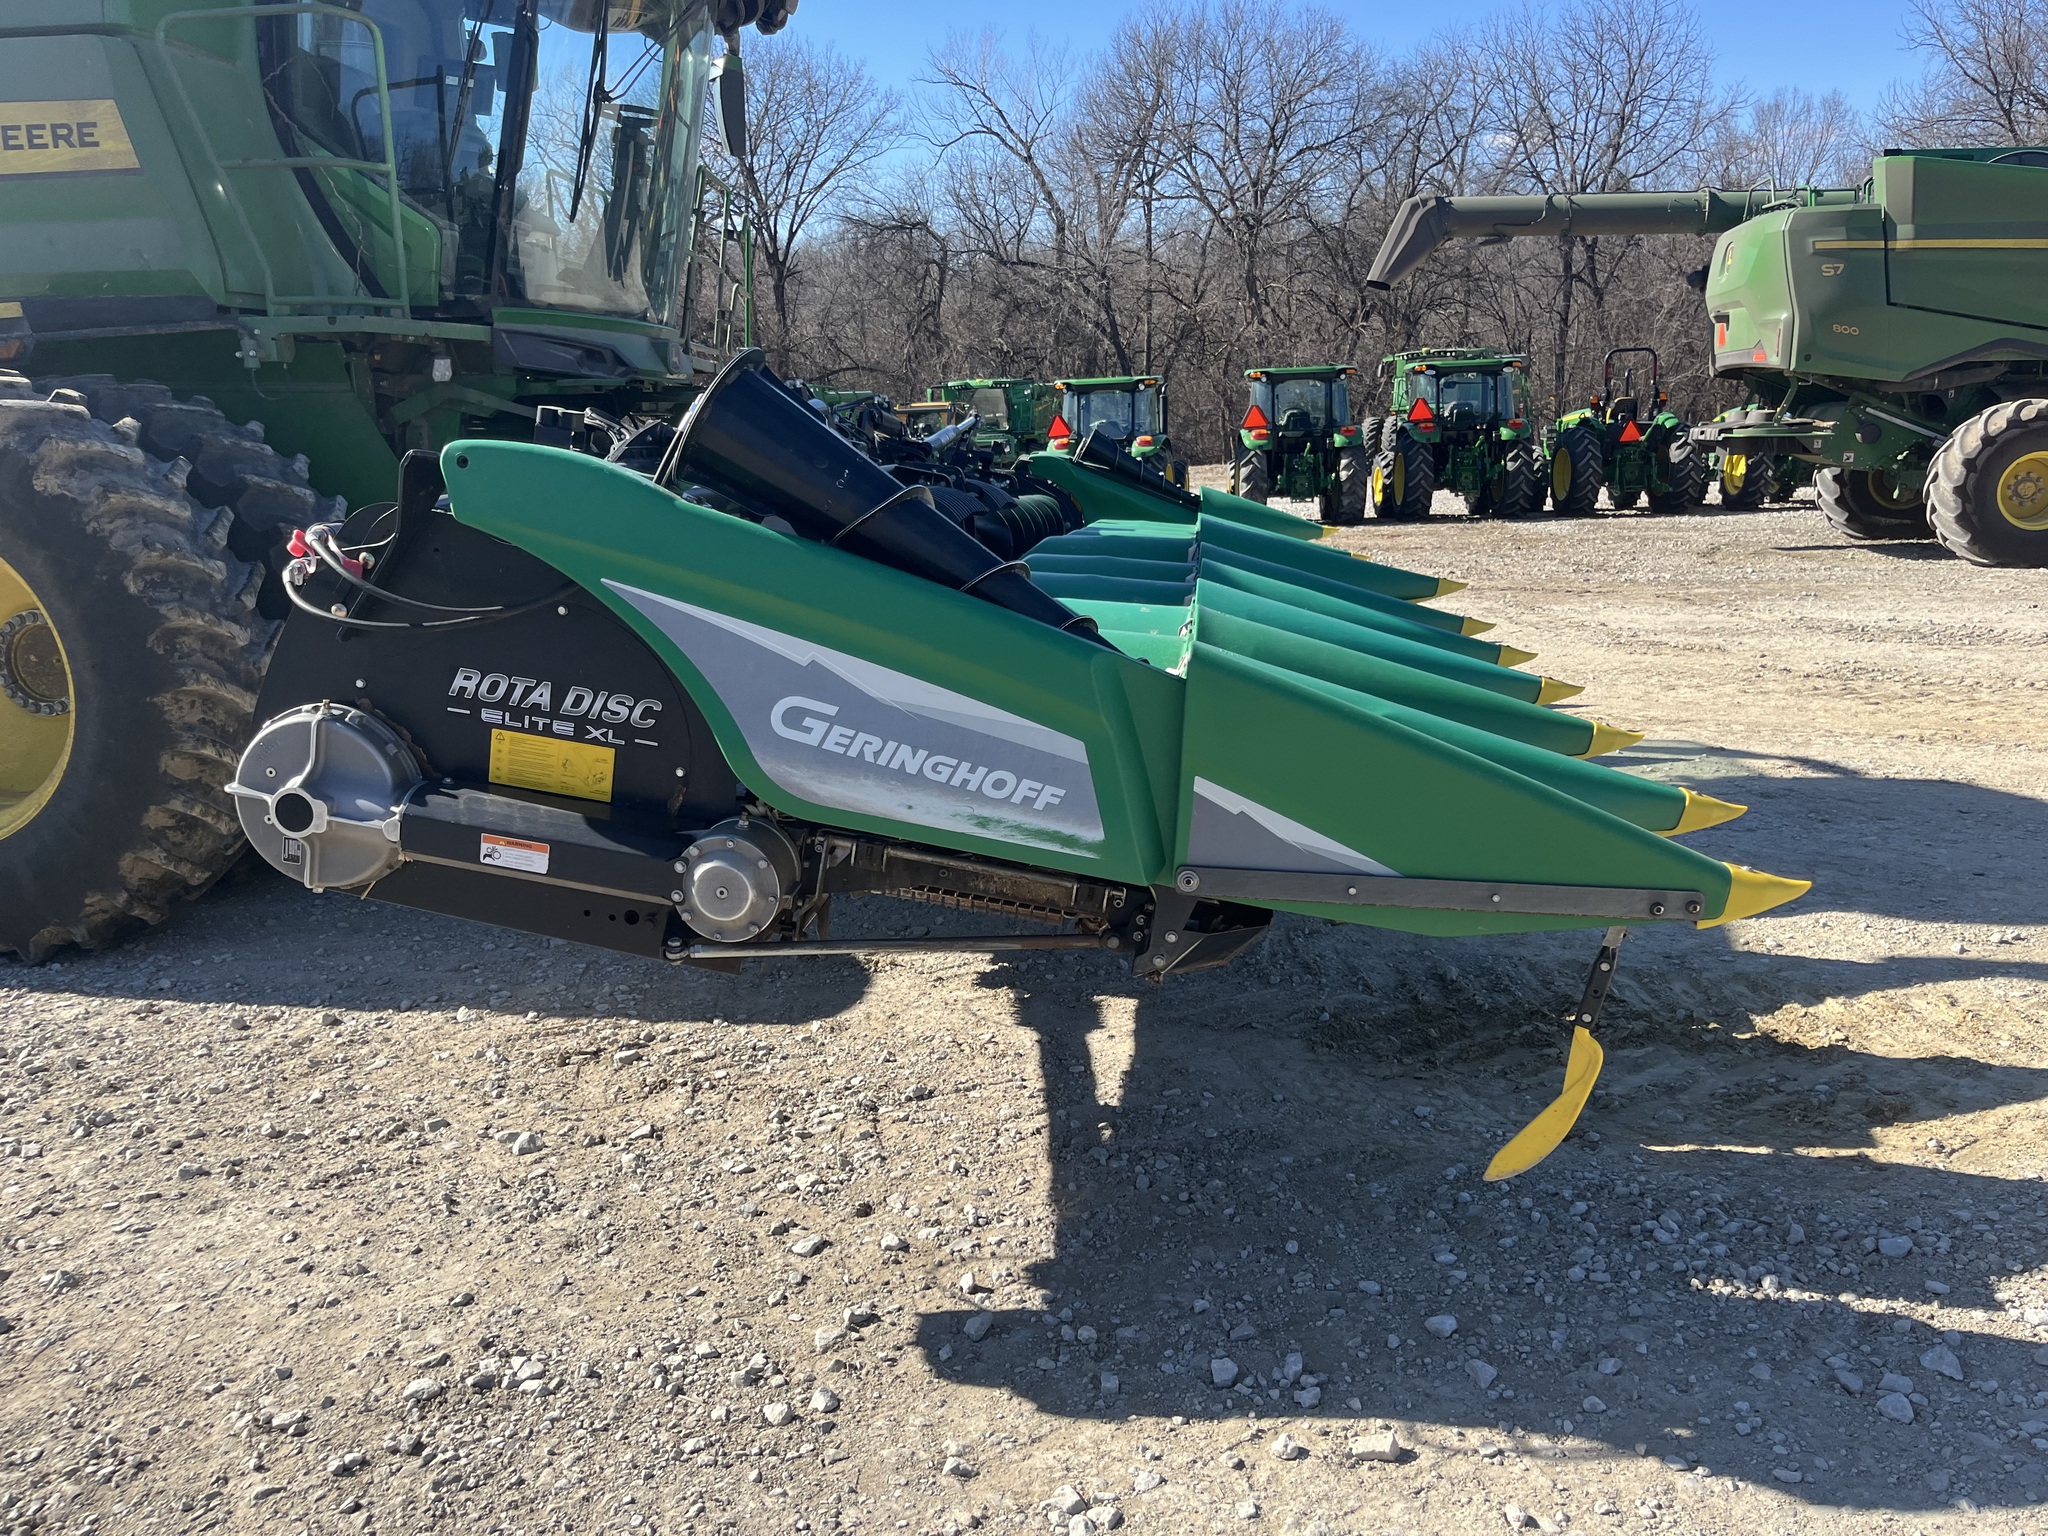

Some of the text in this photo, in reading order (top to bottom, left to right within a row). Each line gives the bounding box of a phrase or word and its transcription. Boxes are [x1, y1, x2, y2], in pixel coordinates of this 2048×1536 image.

[1821, 263, 1845, 276] S7
[1832, 324, 1860, 335] 800
[449, 668, 662, 728] ROTA DISC
[480, 708, 625, 745] ELITE XL
[770, 696, 1067, 811] GERINGHOFF
[506, 841, 533, 849] WARNING
